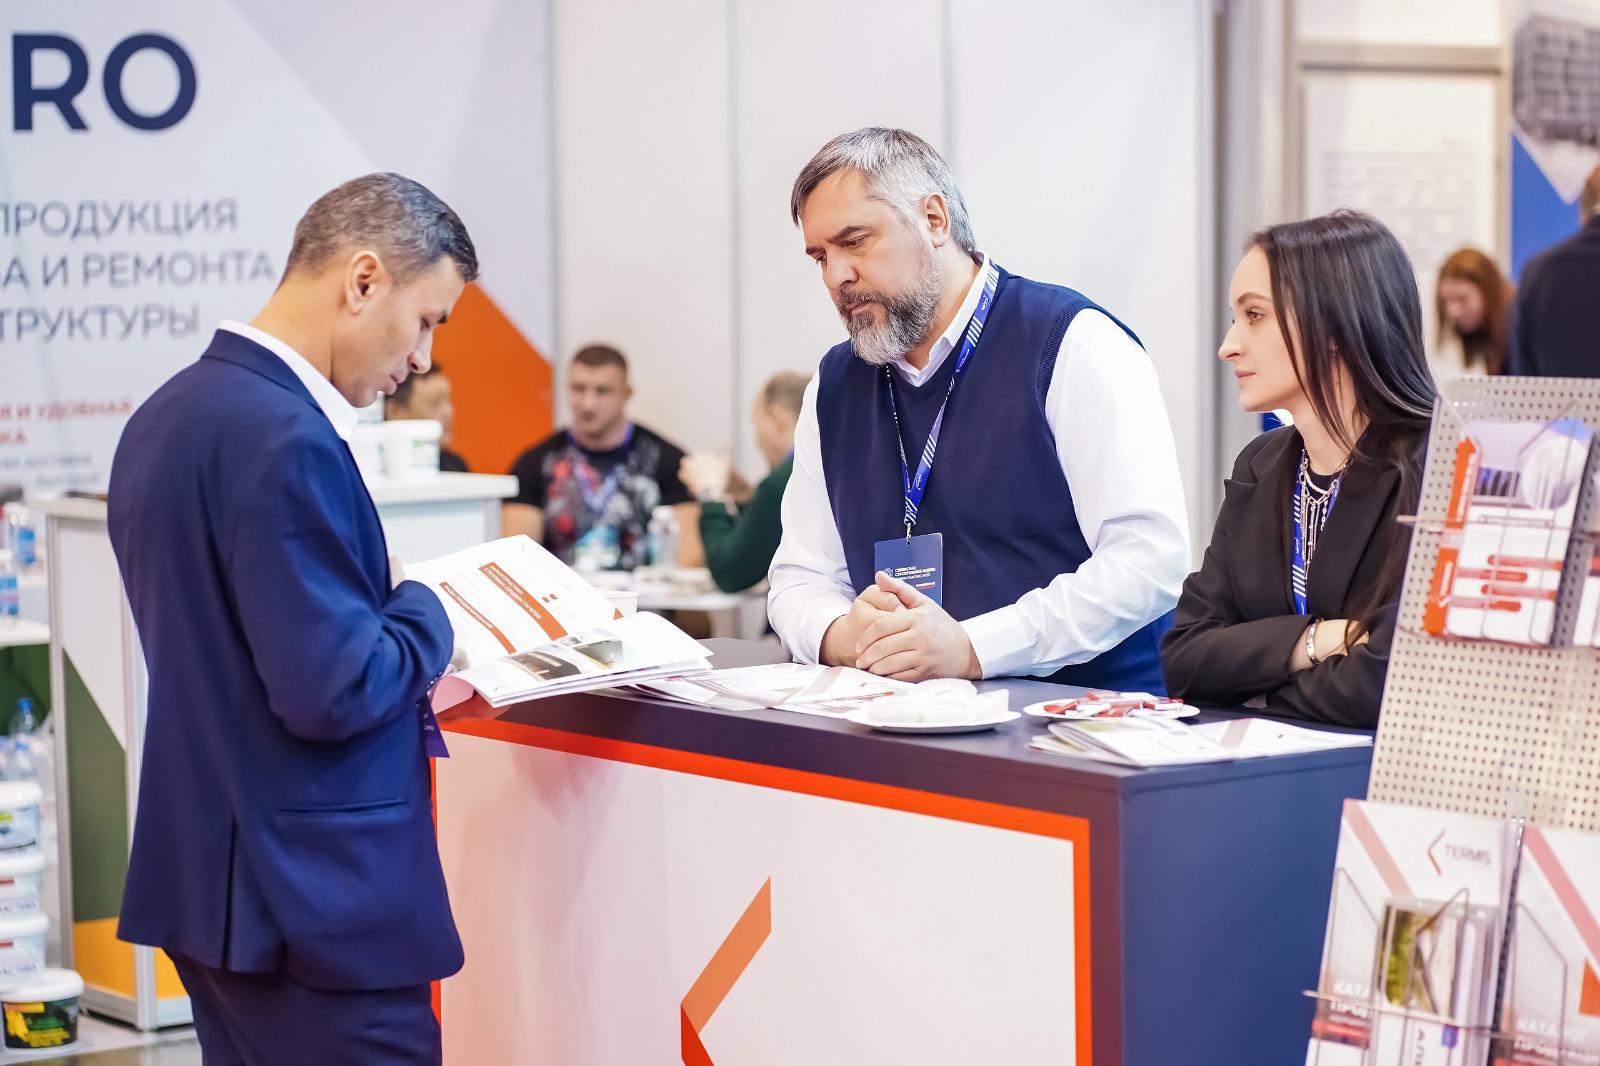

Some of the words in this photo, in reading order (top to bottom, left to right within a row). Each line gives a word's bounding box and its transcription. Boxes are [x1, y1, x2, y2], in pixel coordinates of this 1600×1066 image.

[42, 254, 69, 288] И
[82, 249, 275, 288] РЕМОНТА
[1445, 843, 1491, 866] TERMS
